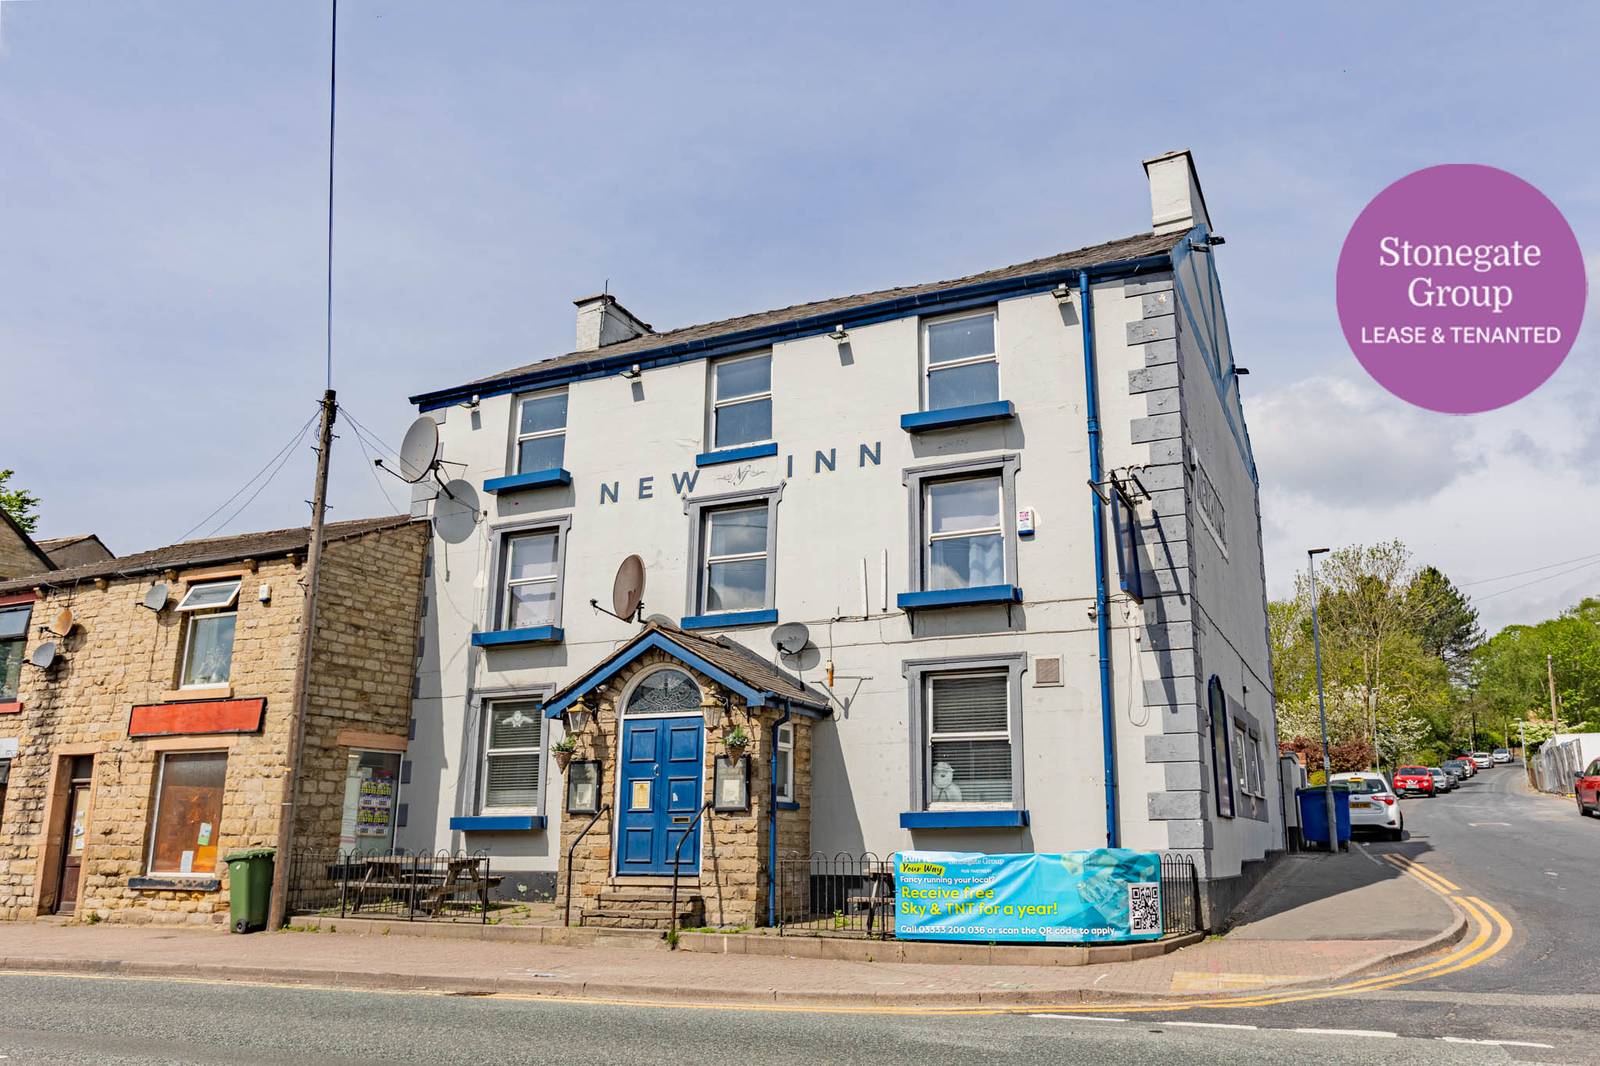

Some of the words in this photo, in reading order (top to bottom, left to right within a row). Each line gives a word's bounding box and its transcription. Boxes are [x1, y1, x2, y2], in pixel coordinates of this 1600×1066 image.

[599, 469, 701, 505] NEW
[787, 441, 882, 478] INN
[902, 863, 921, 873] Your
[924, 864, 943, 875] Way
[900, 876, 922, 885] Fancy
[924, 876, 952, 885] running
[954, 877, 972, 885] your
[972, 876, 996, 884] local?
[901, 886, 959, 899] Receive
[963, 887, 995, 899] free
[901, 902, 926, 918] Sky
[929, 903, 941, 915] &
[945, 903, 974, 915] TNT
[978, 902, 1000, 915] for
[1003, 905, 1014, 915] a
[1018, 902, 1058, 918] year!
[900, 925, 917, 934] Call
[949, 926, 966, 934] 200
[968, 926, 985, 934] 036
[1021, 926, 1037, 935] the
[1038, 927, 1053, 936] QR
[1054, 926, 1077, 935] code
[1079, 927, 1089, 935] to
